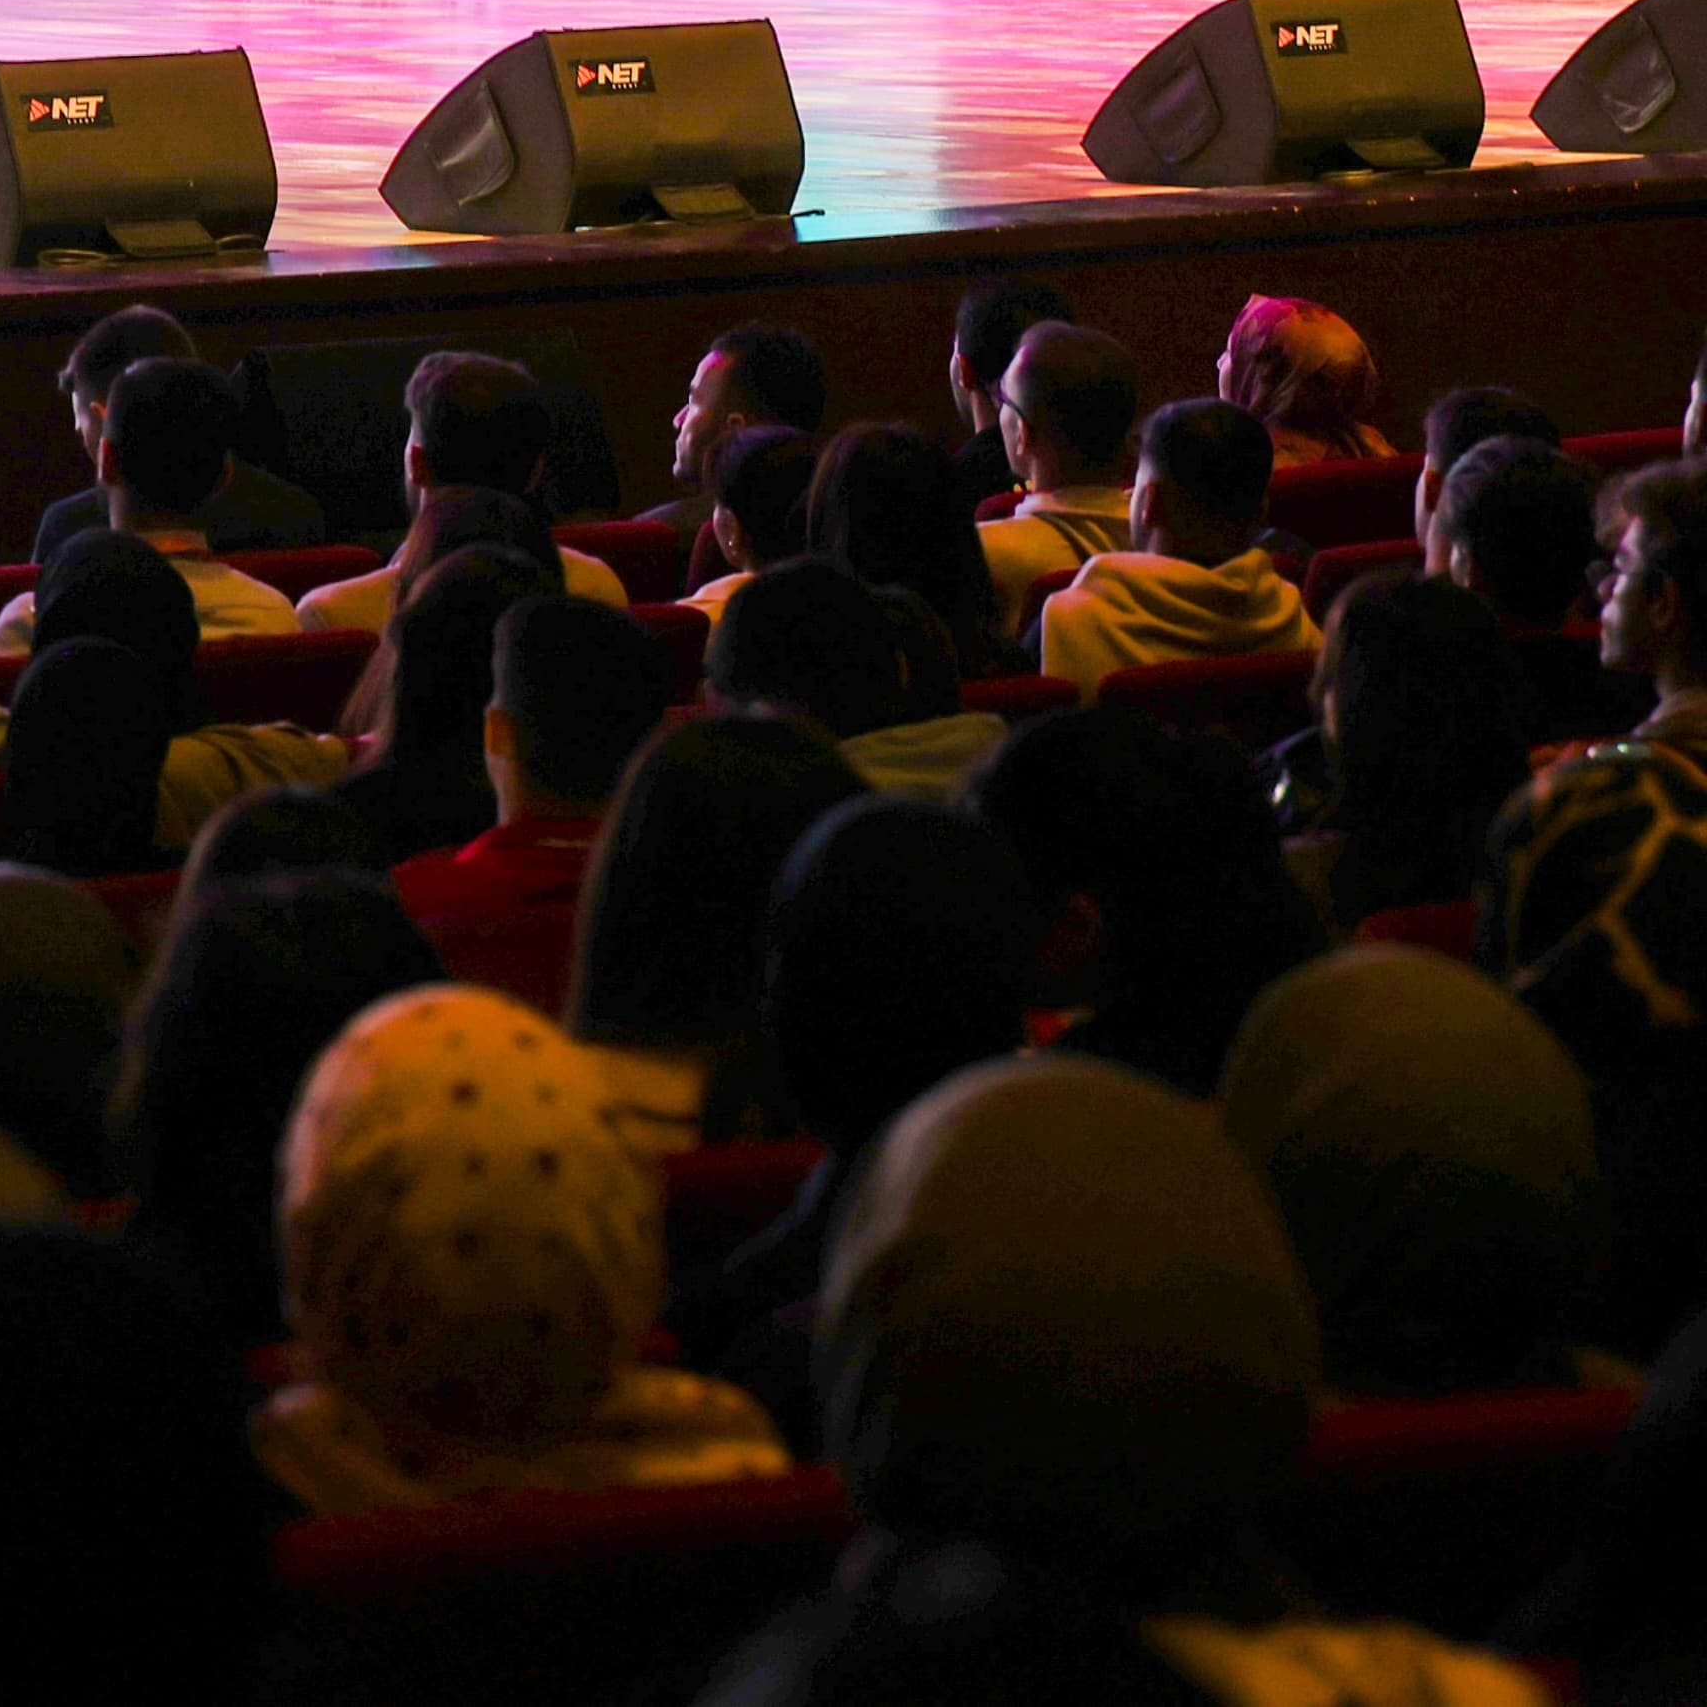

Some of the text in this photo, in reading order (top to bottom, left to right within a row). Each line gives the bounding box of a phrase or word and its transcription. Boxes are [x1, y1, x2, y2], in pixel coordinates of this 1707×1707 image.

[1295, 24, 1340, 47] NET
[597, 61, 646, 85] NET
[51, 95, 105, 120] NET
